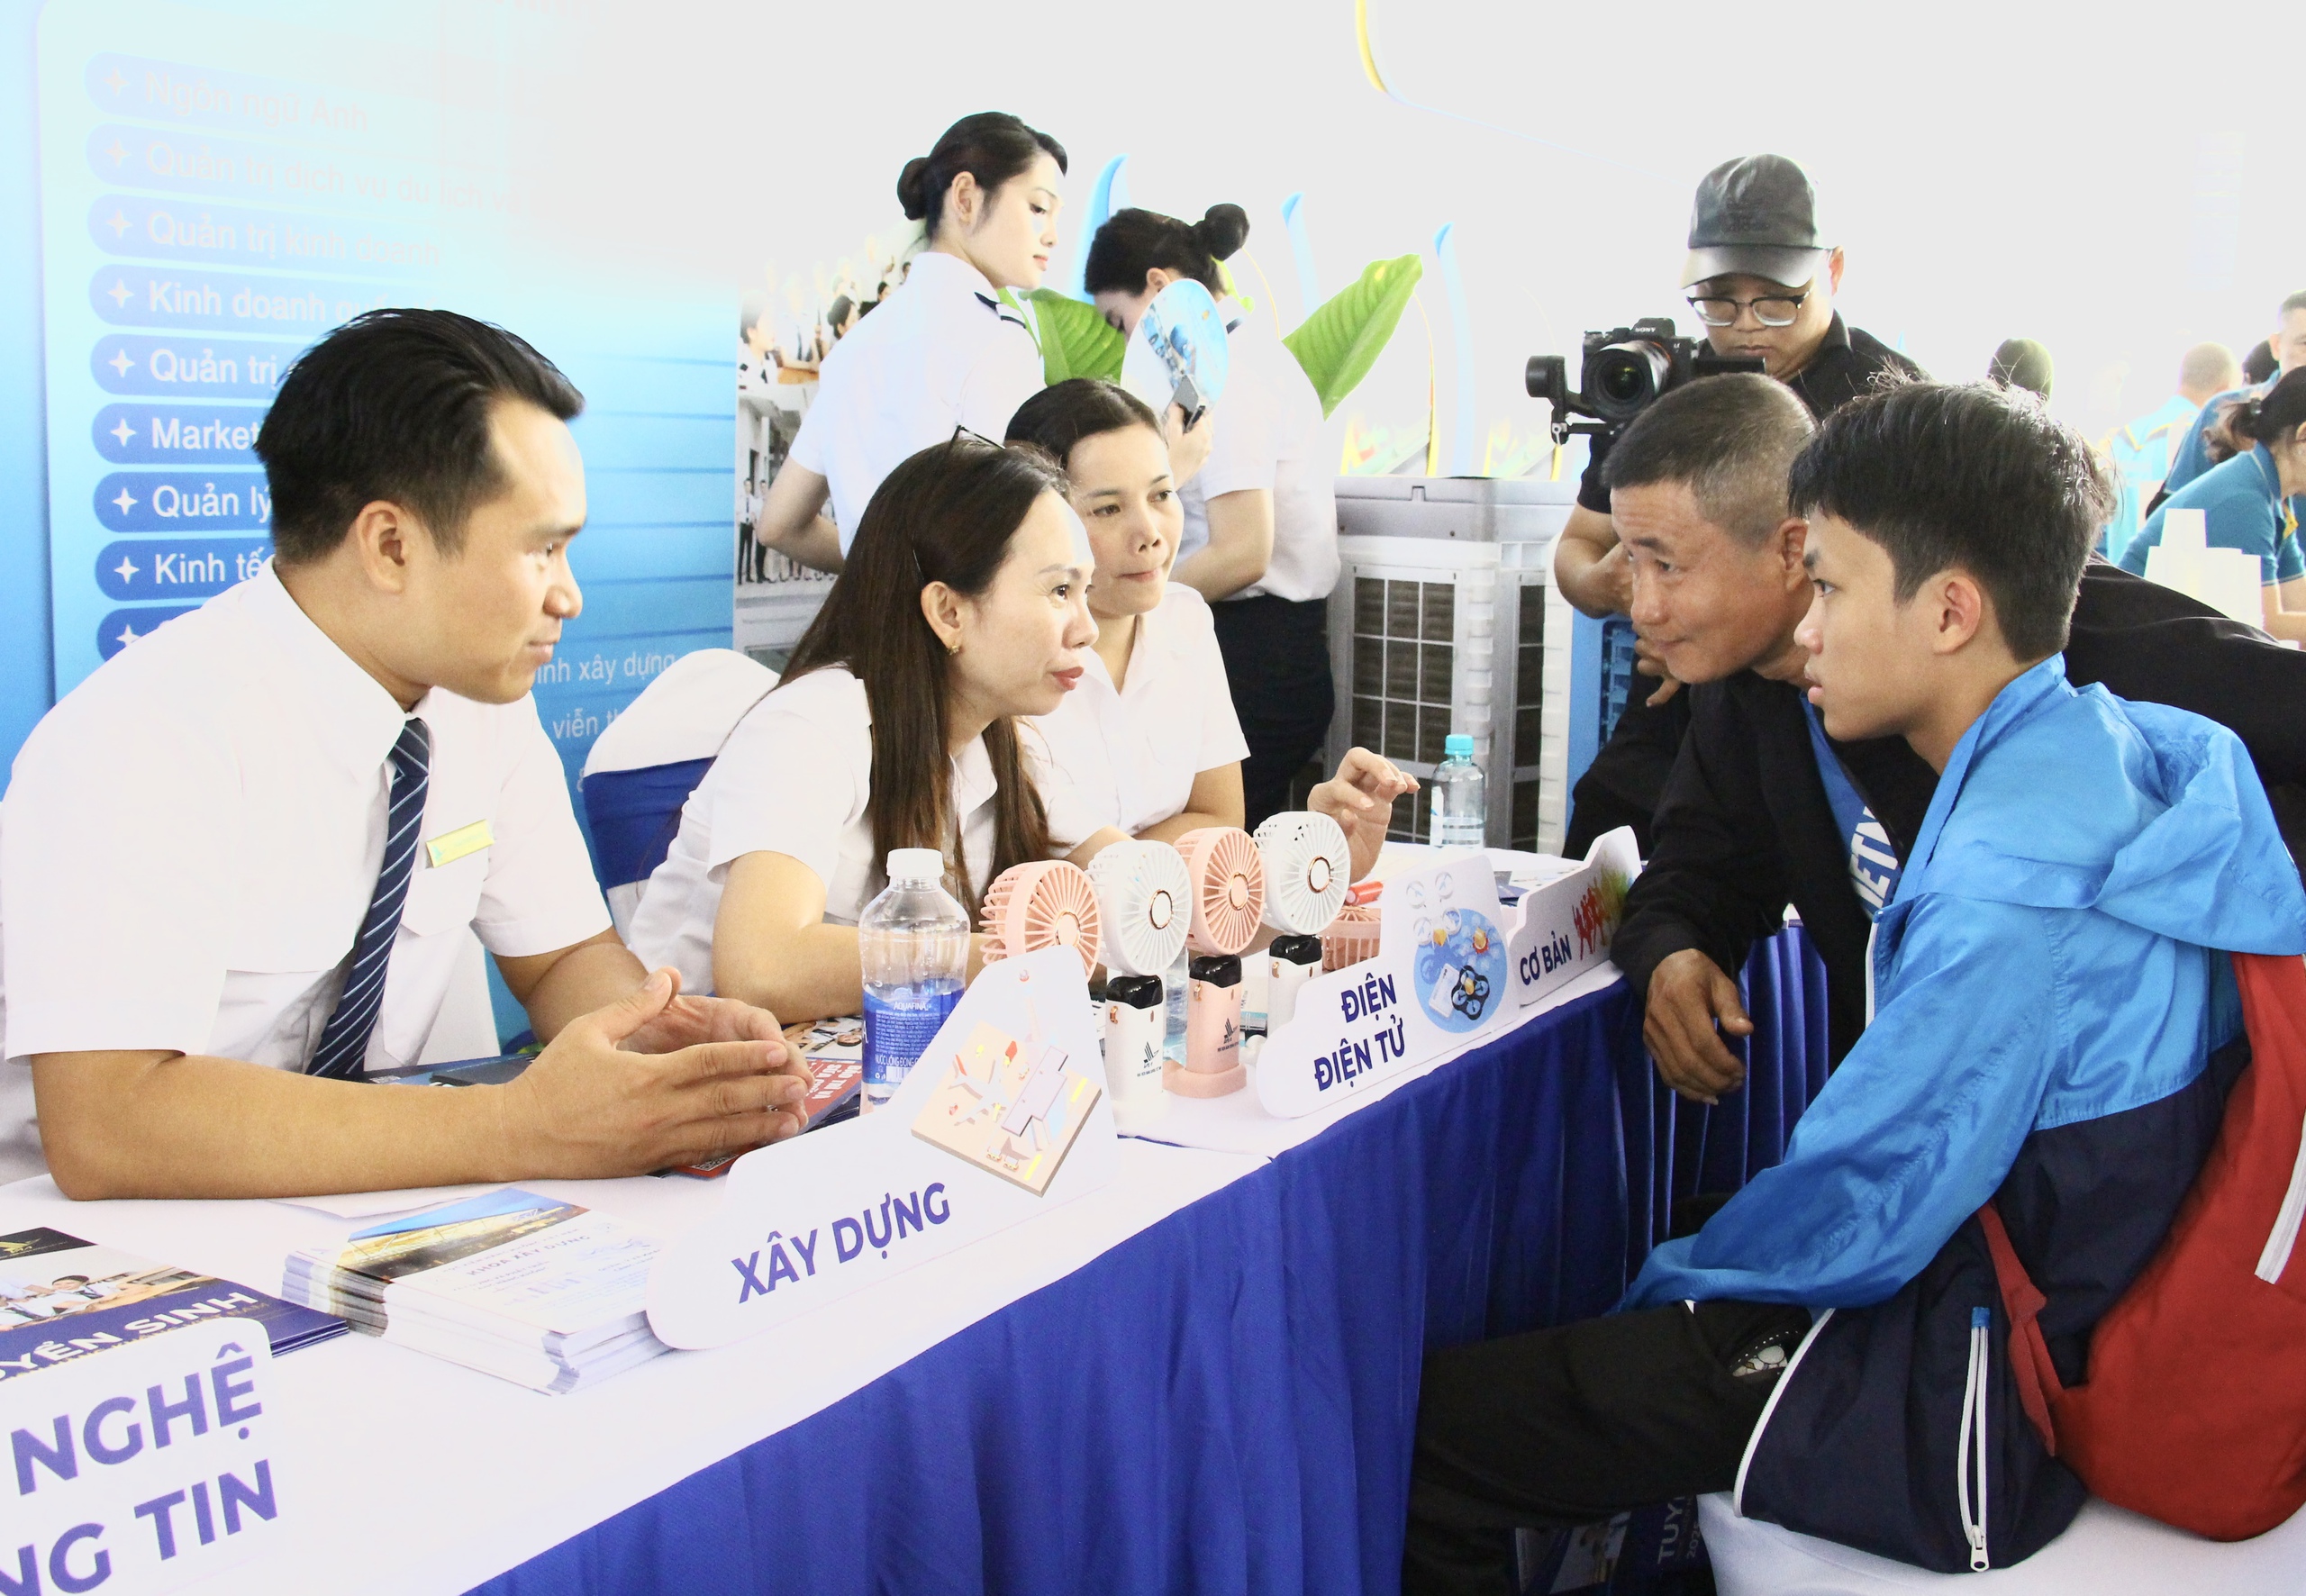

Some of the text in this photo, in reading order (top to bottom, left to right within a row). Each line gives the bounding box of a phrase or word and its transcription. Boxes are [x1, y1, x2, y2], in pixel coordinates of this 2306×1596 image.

[144, 71, 368, 133] Ngôn ngữ Anh
[146, 141, 234, 183] Quản
[245, 155, 276, 186] trị
[285, 162, 345, 195] dịch
[355, 177, 387, 200] vụ
[397, 175, 431, 203] du
[147, 211, 440, 268] Quản trị kinh doanh
[149, 279, 222, 316] Kinh
[232, 287, 325, 322] doanh
[150, 349, 277, 390] Quản trị
[151, 417, 261, 450] Market
[152, 482, 270, 523] Quản lý
[154, 546, 264, 584] Kinh tế
[578, 653, 617, 685] xây
[553, 707, 599, 739] viễn
[1520, 930, 1573, 986] CƠ BẢN
[893, 1001, 928, 1011] AQUAFINA
[1340, 972, 1397, 1023] ĐIỆN
[1313, 1013, 1405, 1092] ĐIỆN TỬ
[731, 1229, 819, 1304] XÂY
[831, 1182, 951, 1264] DỰNG
[0, 1291, 259, 1381] YỂN SINH
[11, 1341, 262, 1496] NGHỆ
[133, 1458, 278, 1561] TIN
[1657, 1496, 1684, 1564] TUY
